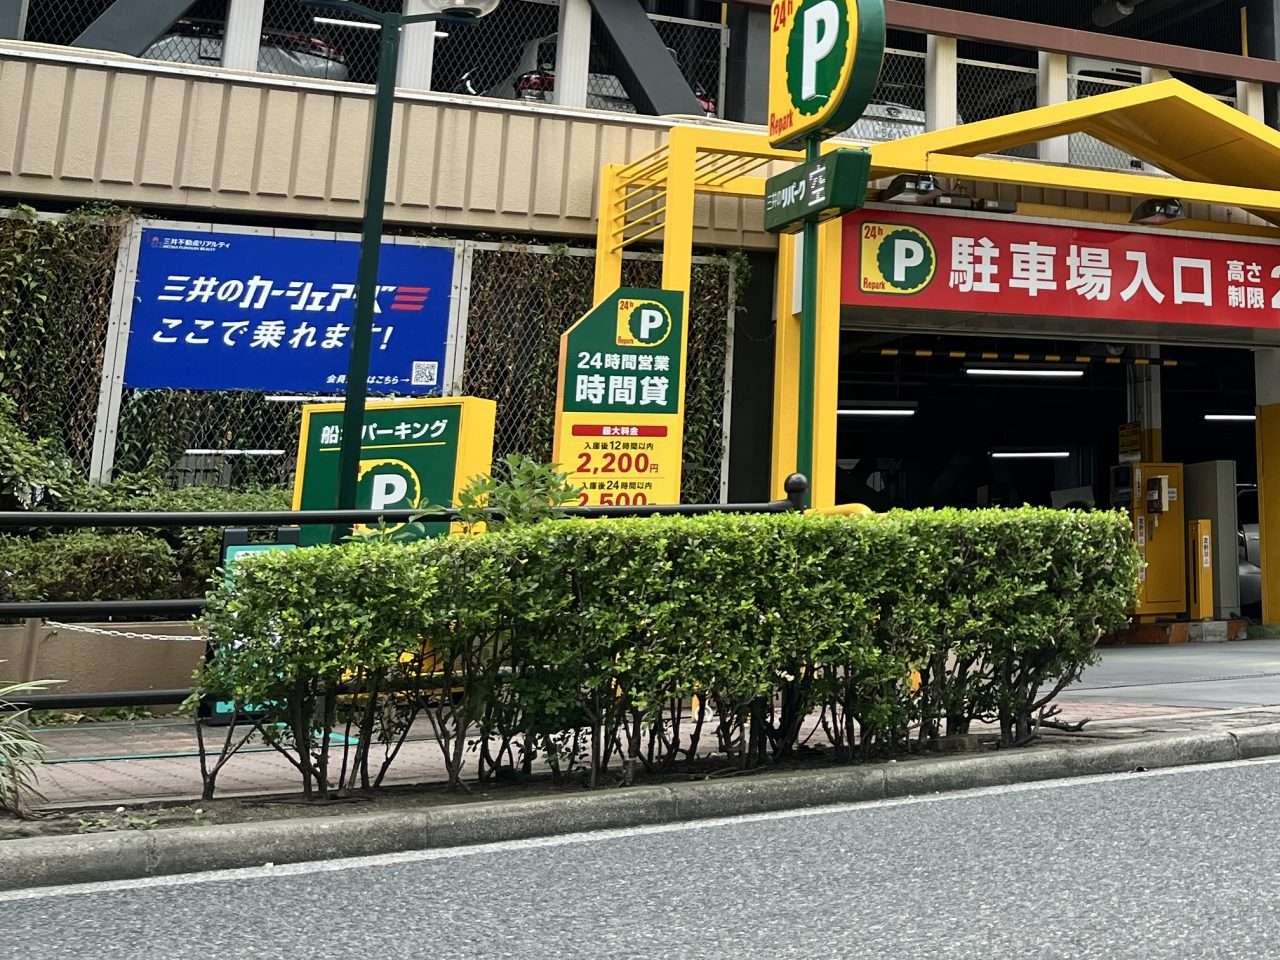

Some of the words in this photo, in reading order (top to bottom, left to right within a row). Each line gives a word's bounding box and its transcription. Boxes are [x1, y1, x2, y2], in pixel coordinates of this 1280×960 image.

[801, 0, 840, 101] P
[770, 109, 794, 136] Repark
[864, 225, 884, 239] 24h
[894, 239, 924, 281] P
[949, 236, 1213, 306] 駐車場入口
[1226, 259, 1262, 283] 高さ
[1228, 285, 1265, 309] 制限
[640, 309, 664, 339] P
[577, 351, 670, 372] 24時間営業
[575, 375, 670, 406] 時間貸
[320, 419, 448, 444] 船パーキング
[584, 440, 654, 450] 入庫後12時間以内
[576, 452, 659, 474] 2,200円
[371, 474, 407, 510] P
